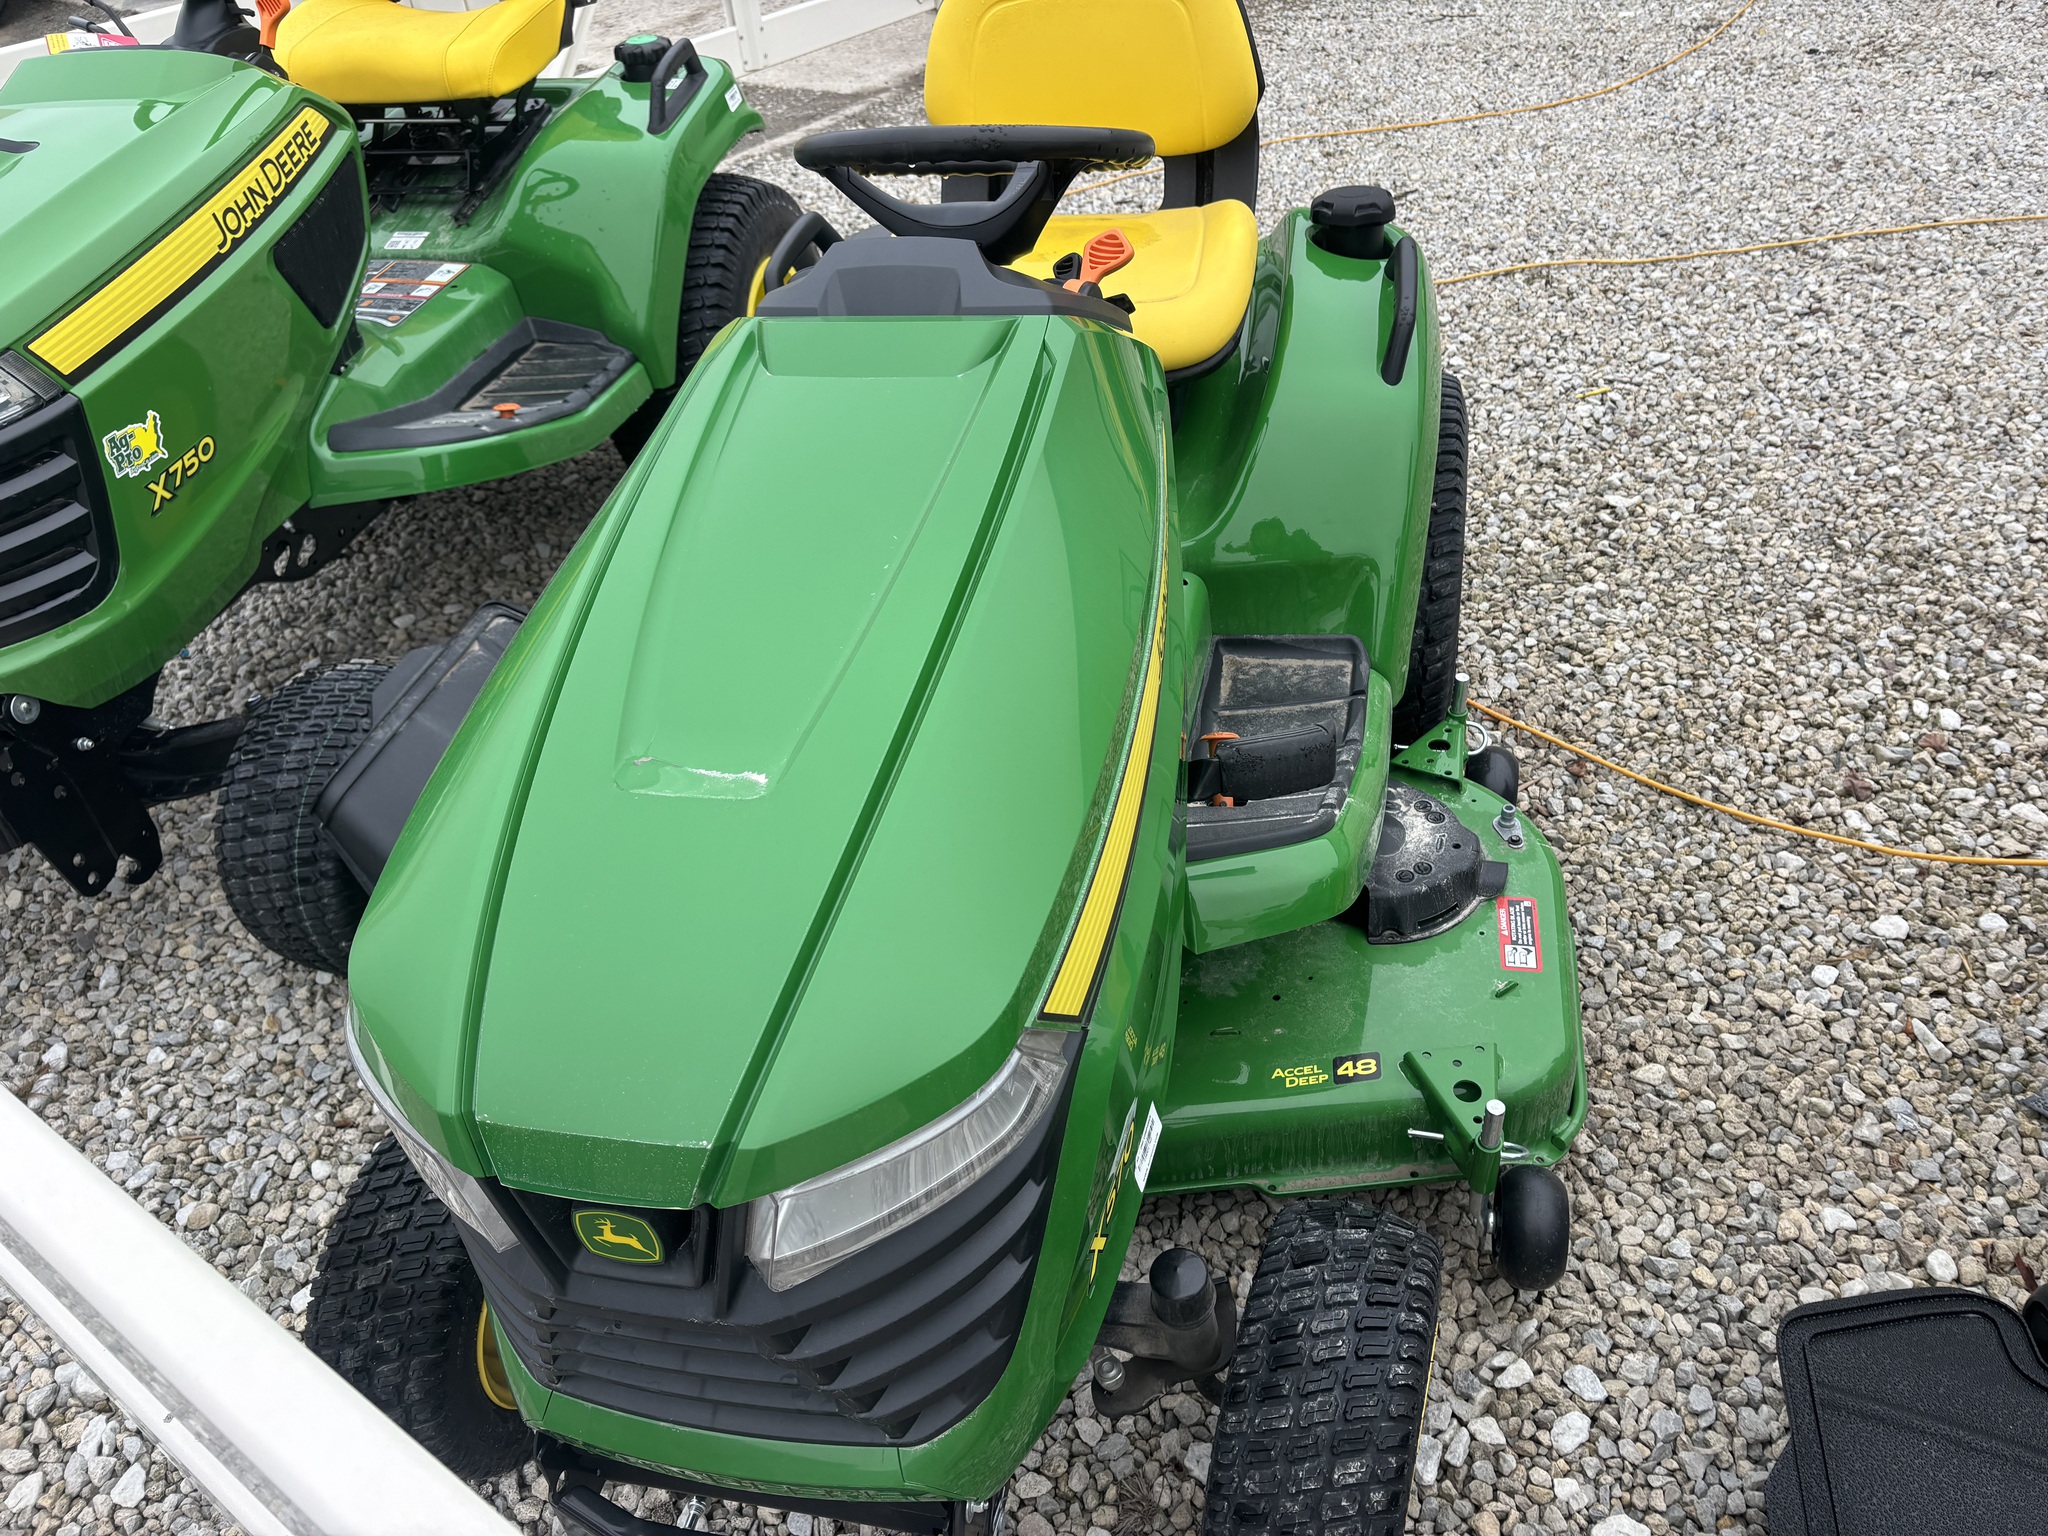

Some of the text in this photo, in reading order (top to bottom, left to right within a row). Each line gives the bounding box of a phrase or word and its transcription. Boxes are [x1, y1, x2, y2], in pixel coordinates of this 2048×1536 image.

[211, 120, 319, 251] JOHN DEERE
[107, 432, 135, 457] Ag-
[113, 446, 143, 473] Pro
[146, 435, 216, 514] X750
[1499, 908, 1507, 930] DANGER
[1271, 1064, 1323, 1079] ACCEL
[1336, 1058, 1378, 1077] 48
[1285, 1074, 1329, 1088] DEEP
[1089, 1120, 1136, 1288] X570
